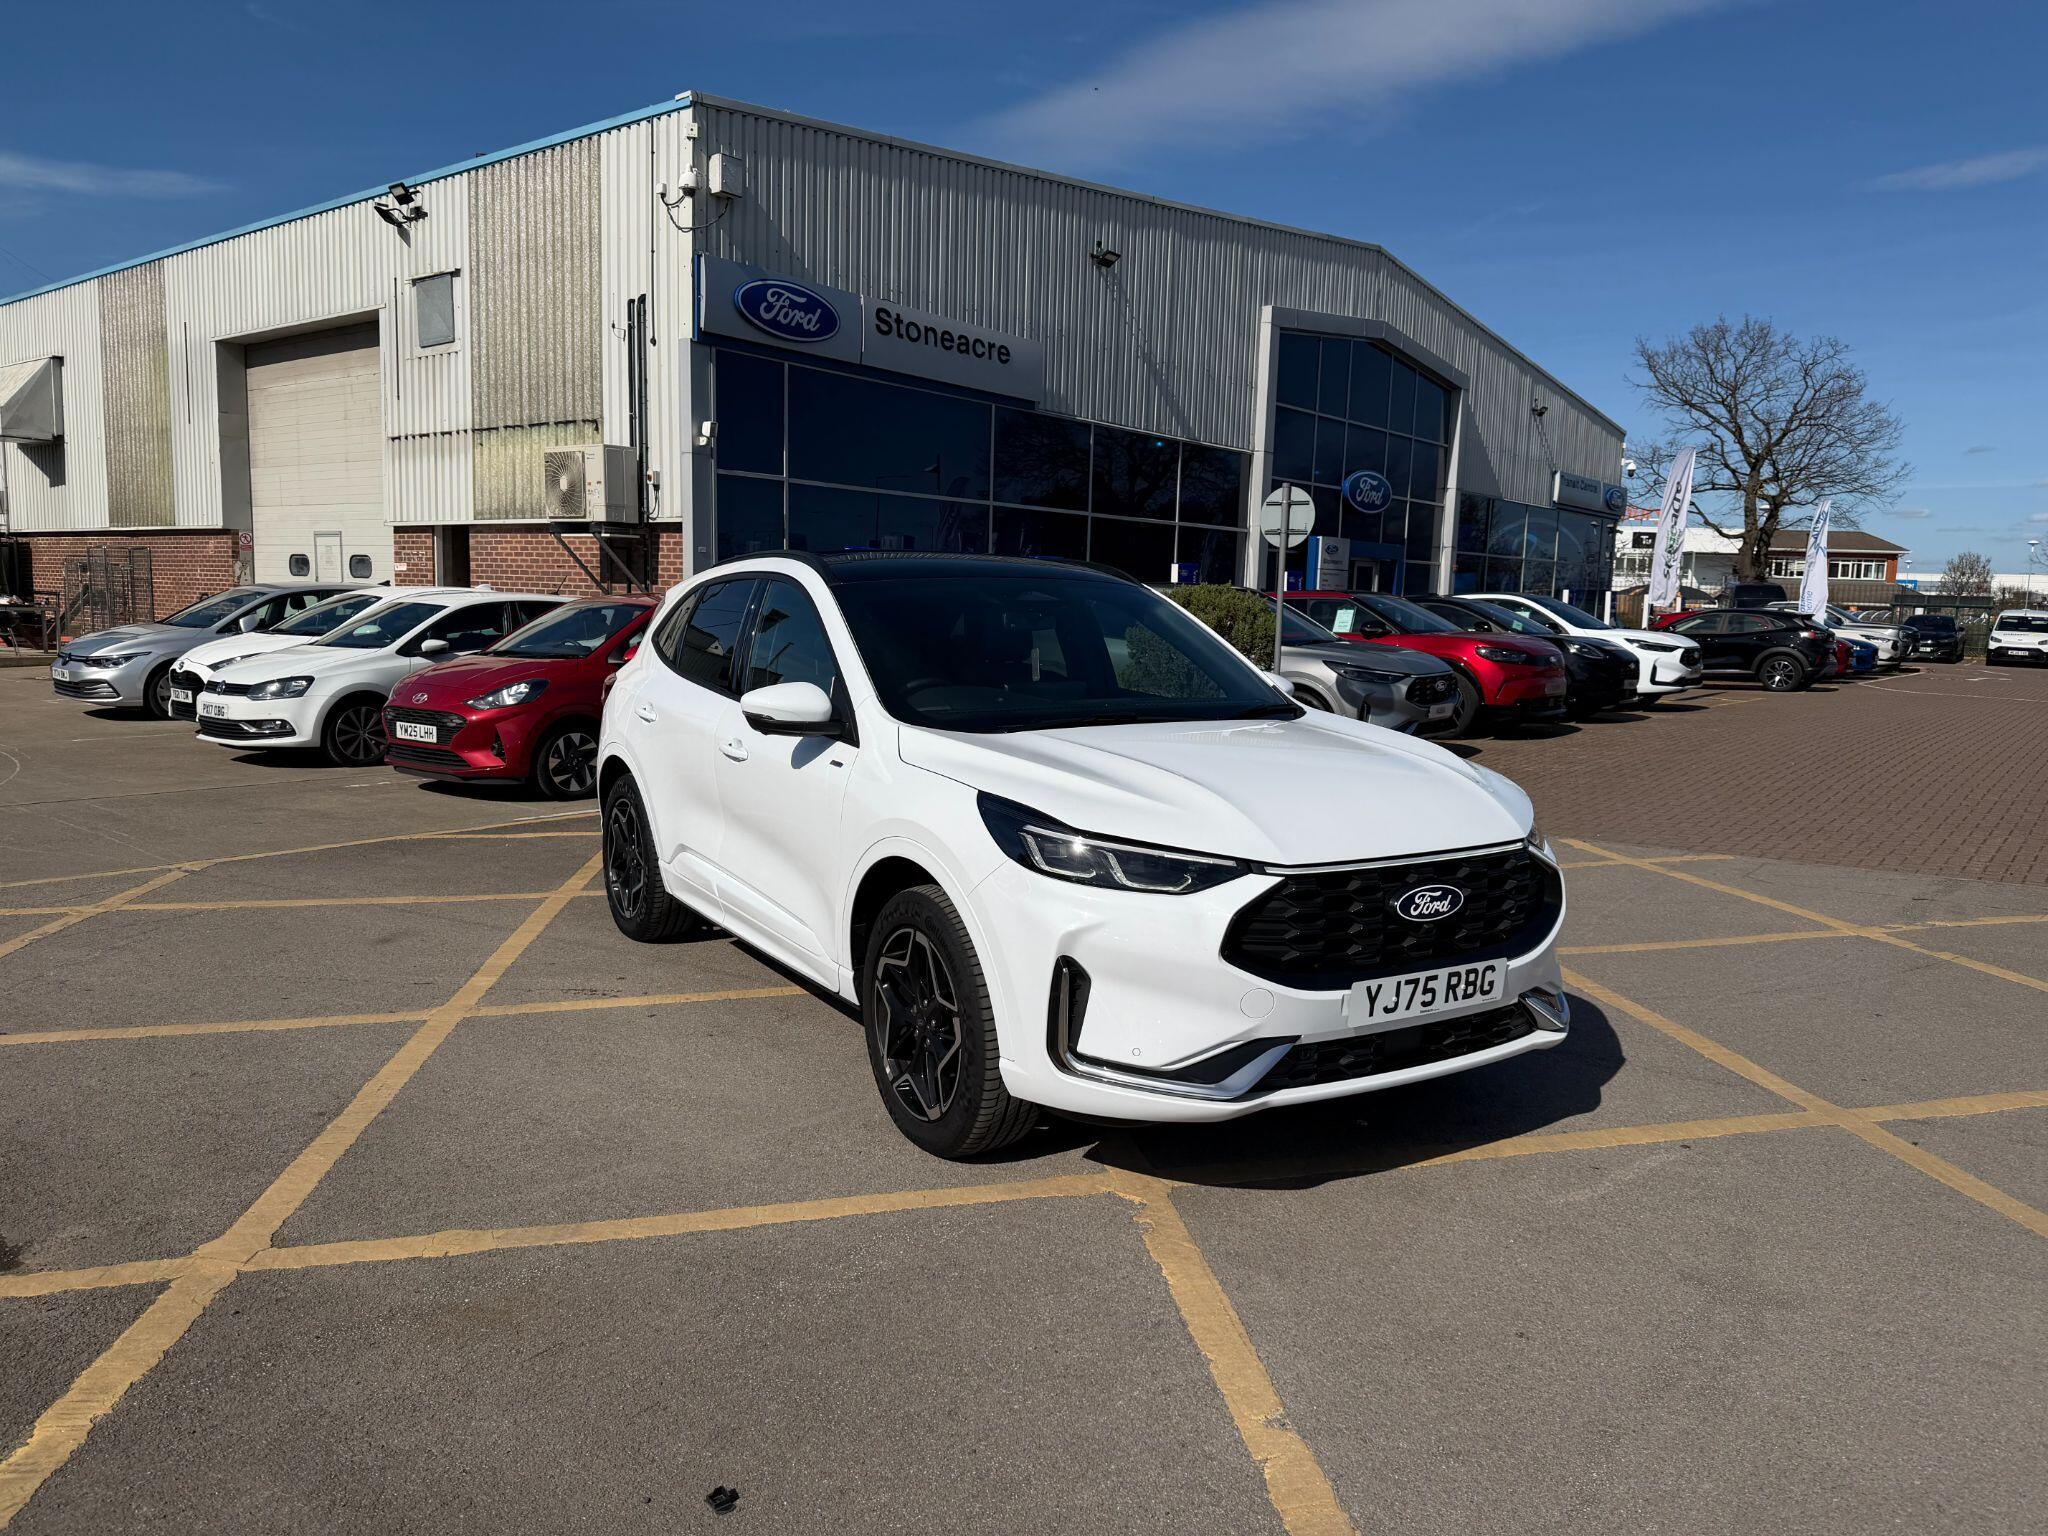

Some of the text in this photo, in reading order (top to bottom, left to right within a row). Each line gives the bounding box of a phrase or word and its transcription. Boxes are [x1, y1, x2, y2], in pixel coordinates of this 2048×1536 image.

[760, 288, 821, 331] Ford
[875, 307, 1011, 365] Stoneacre
[1356, 476, 1384, 505] Ford
[399, 723, 434, 740] YM25 LHH
[1410, 890, 1452, 916] Ford
[1366, 965, 1496, 1017] YJ75 RBG
